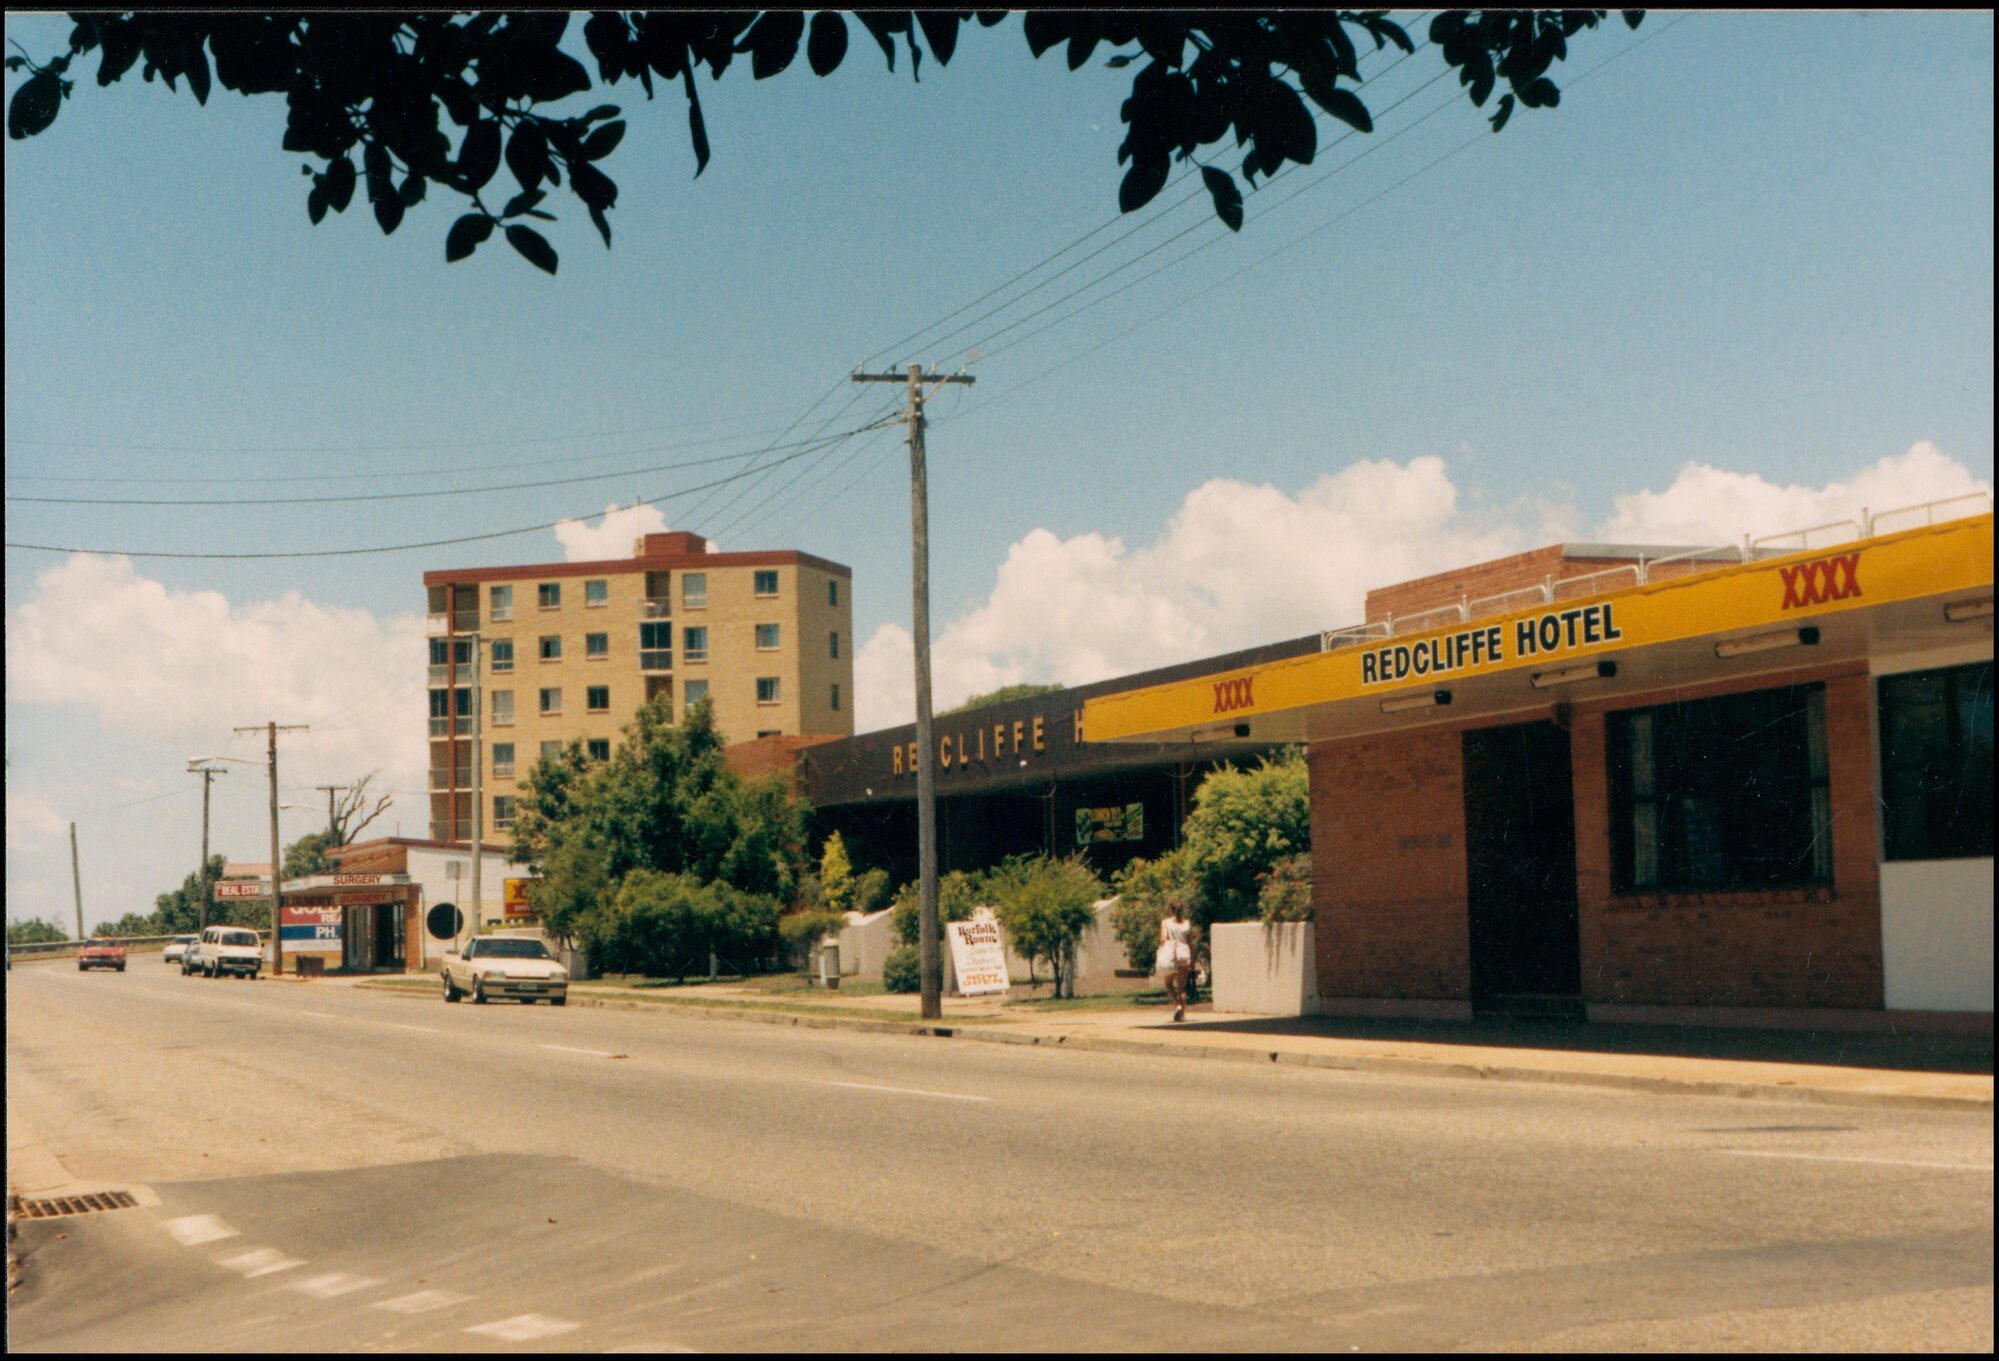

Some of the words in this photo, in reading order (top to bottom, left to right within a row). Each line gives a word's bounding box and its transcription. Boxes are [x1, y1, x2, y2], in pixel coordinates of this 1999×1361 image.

[1778, 552, 1862, 610] XXXX
[1361, 626, 1502, 686] REDCLIFFE
[1515, 602, 1622, 658] HOTEL
[1213, 676, 1254, 713] XXXX
[893, 714, 1044, 775] RECLIFFE
[222, 885, 240, 896] REAL
[333, 875, 381, 885] SURGERY
[315, 926, 339, 939] PH.
